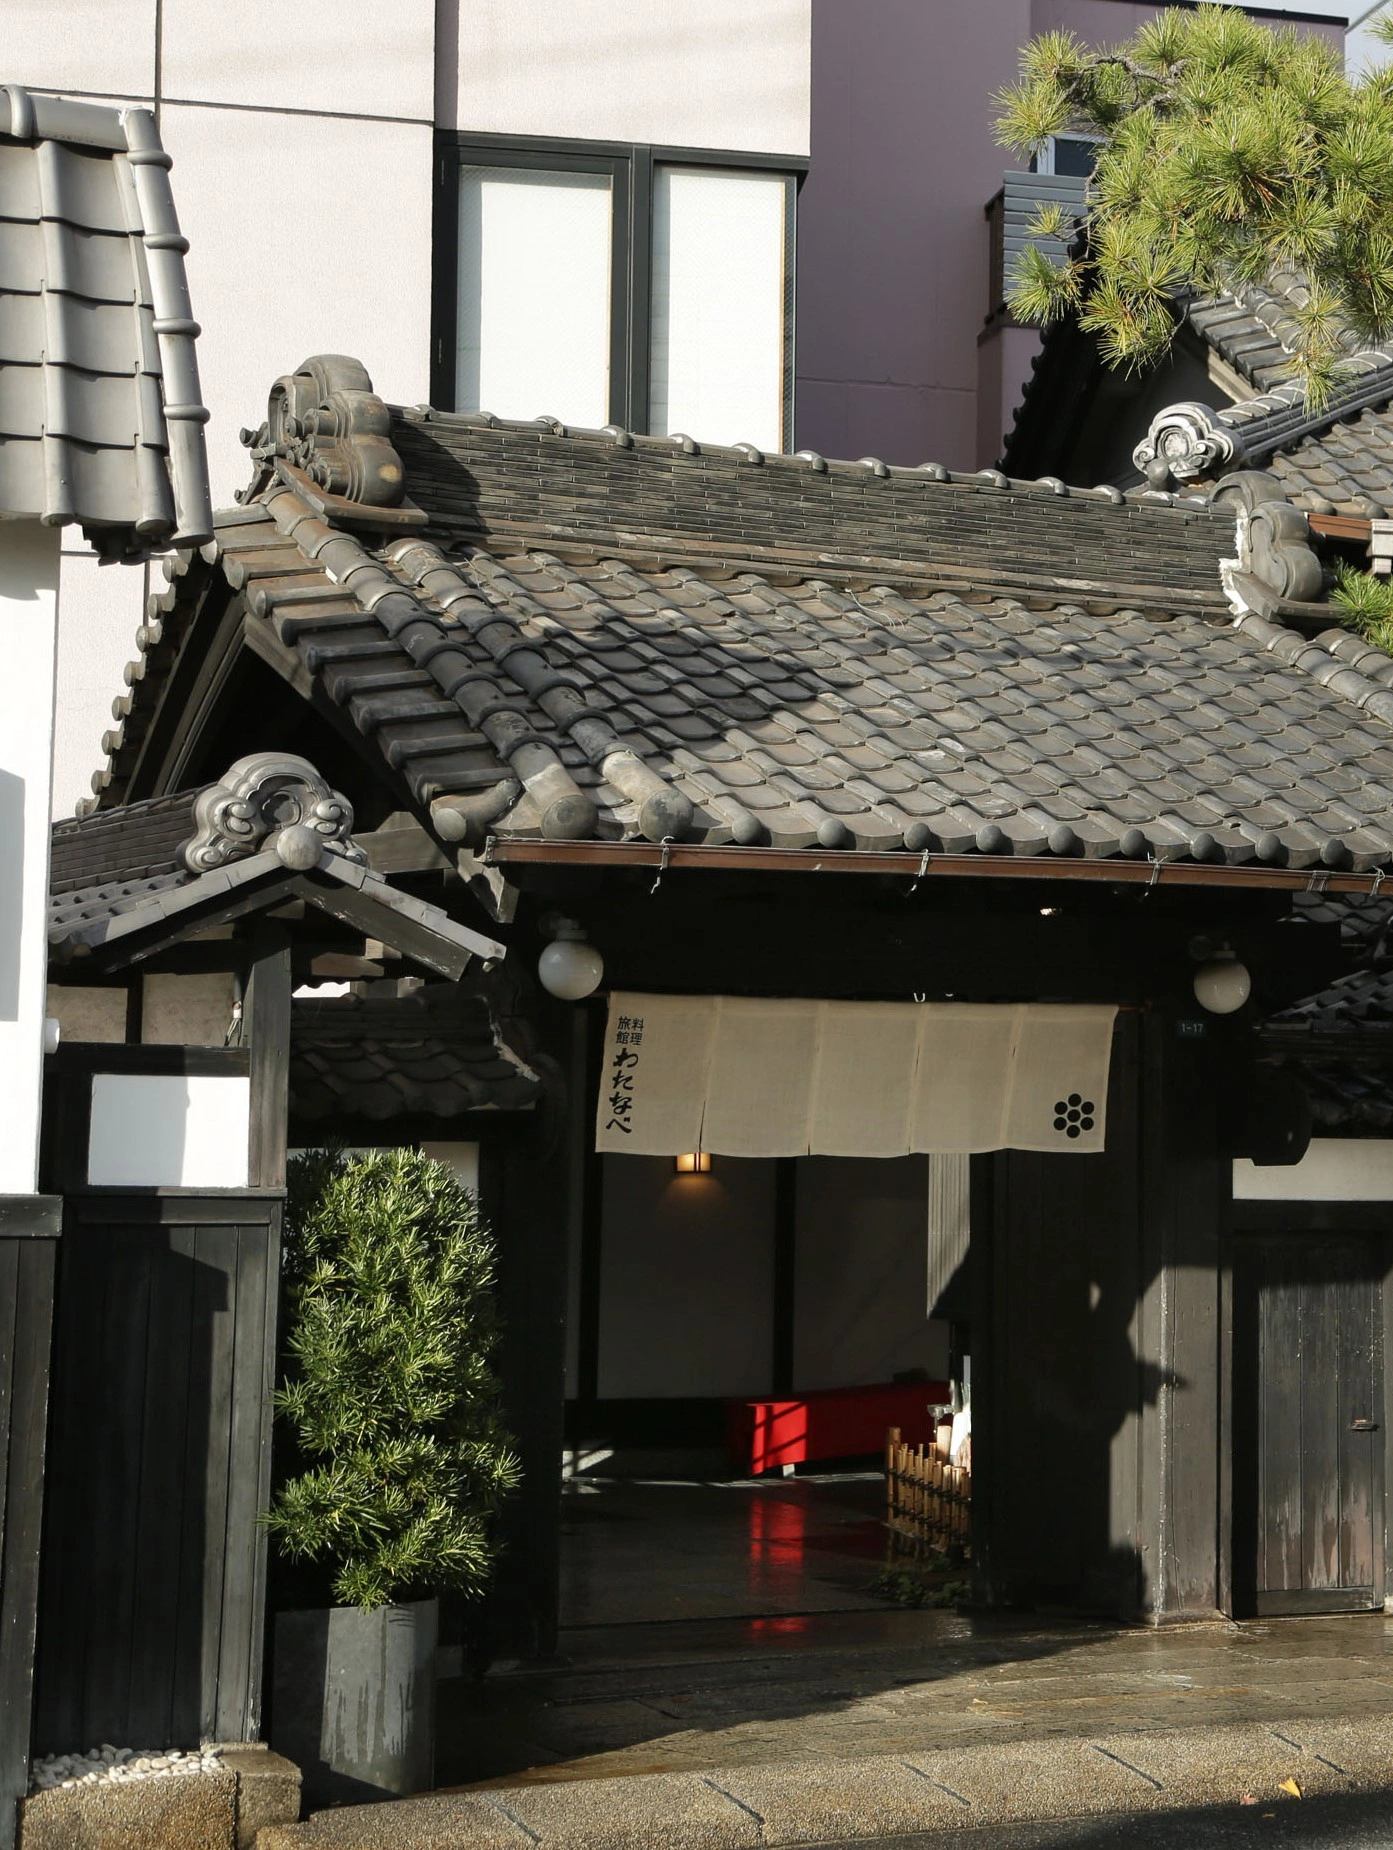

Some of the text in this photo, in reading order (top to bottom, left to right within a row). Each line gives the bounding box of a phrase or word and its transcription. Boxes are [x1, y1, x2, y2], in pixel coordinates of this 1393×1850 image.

[616, 1016, 631, 1045] 旅館
[629, 1017, 645, 1046] 料理
[1181, 1023, 1204, 1033] 1-17
[605, 1047, 639, 1134] わたなべ
